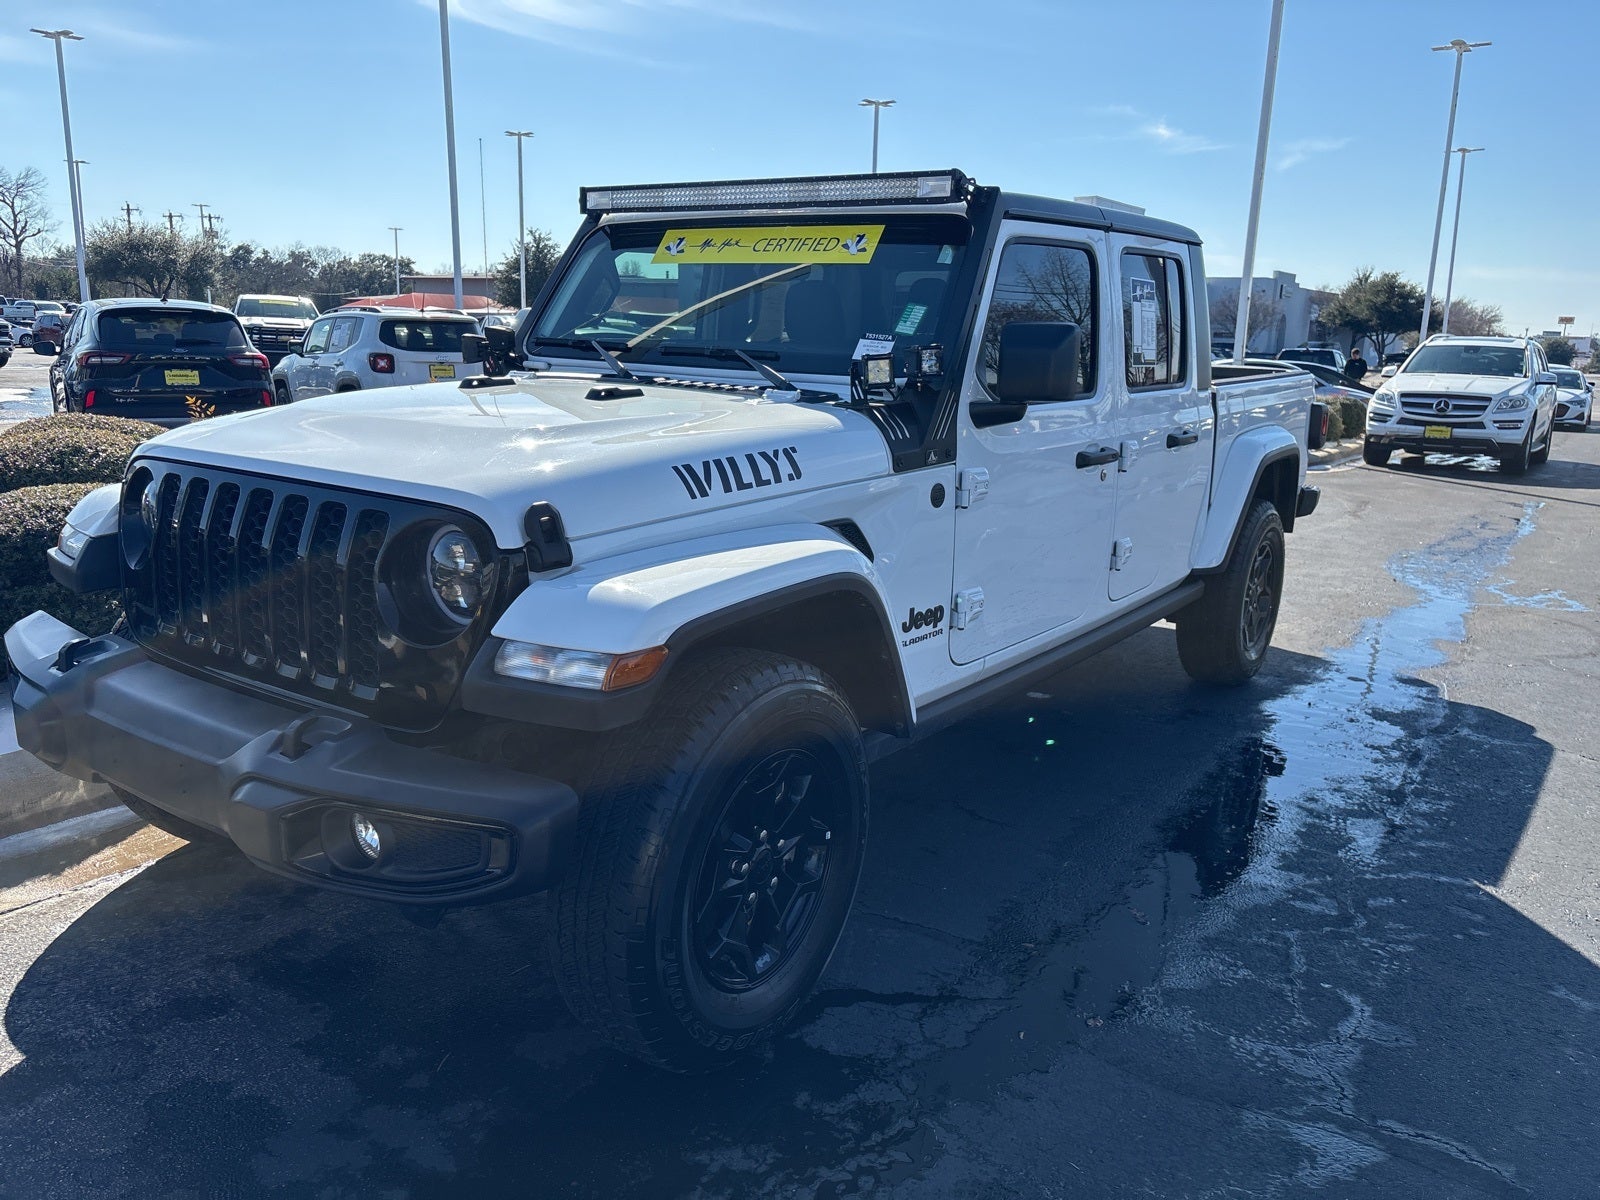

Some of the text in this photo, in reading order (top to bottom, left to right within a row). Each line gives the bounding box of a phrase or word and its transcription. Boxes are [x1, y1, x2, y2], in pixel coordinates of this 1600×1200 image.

[752, 236, 842, 253] CERTIFIED
[671, 446, 802, 500] WILLYS
[901, 604, 945, 634] Jeep
